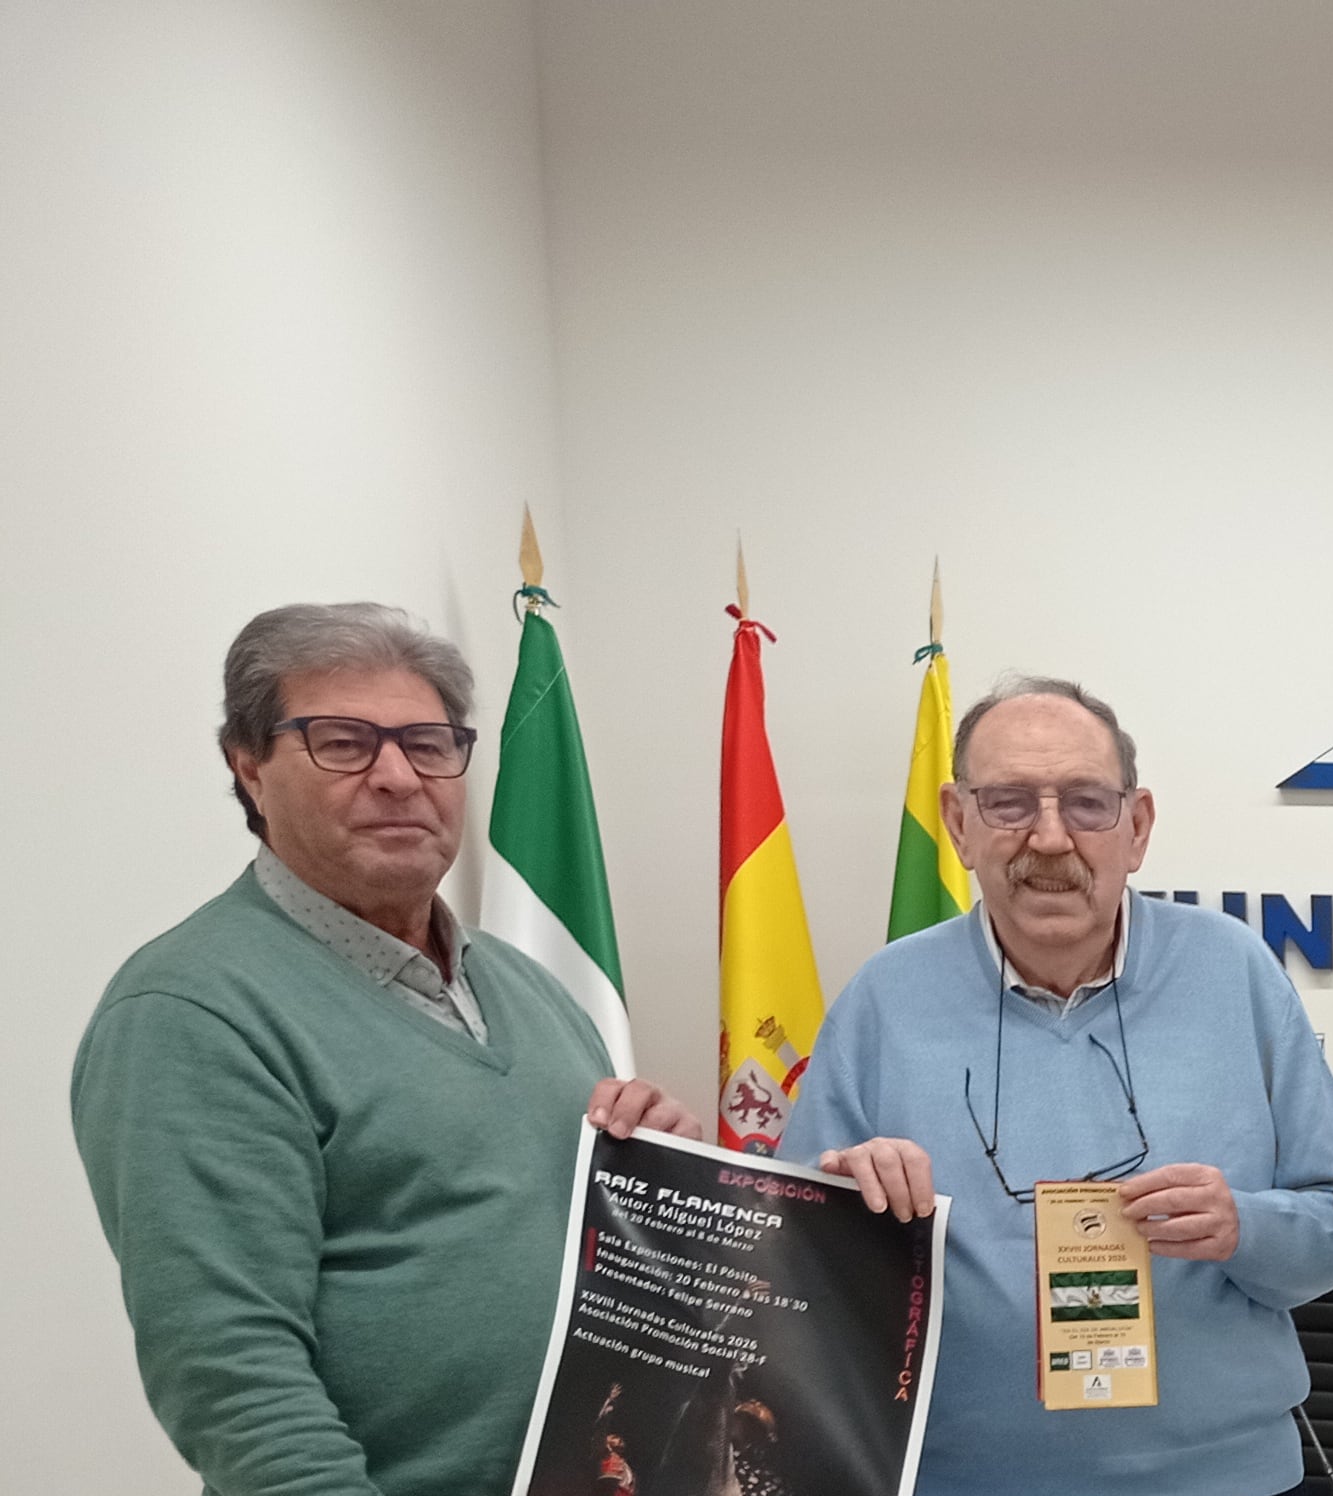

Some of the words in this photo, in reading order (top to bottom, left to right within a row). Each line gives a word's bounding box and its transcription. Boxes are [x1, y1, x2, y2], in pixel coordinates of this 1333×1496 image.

[595, 1170, 649, 1195] RAÍZ
[657, 1187, 783, 1229] FLAMENCA
[717, 1169, 826, 1204] EXPOSICIÓN
[658, 1204, 712, 1228] Miguel
[716, 1219, 762, 1241] López
[722, 1236, 754, 1252] Marzo
[598, 1232, 622, 1248] Sala
[624, 1238, 702, 1272] Exposiciones:
[705, 1262, 718, 1274] El
[719, 1265, 758, 1284] Pósito
[668, 1288, 703, 1308] Felipe
[705, 1298, 753, 1319] Serrano
[675, 1272, 690, 1286] 20
[693, 1277, 739, 1298] Febrero
[753, 1291, 770, 1304] las
[578, 1303, 639, 1331] Asociación
[641, 1324, 699, 1351] Promoción
[701, 1342, 738, 1361] Social
[580, 1289, 615, 1309] XXVIII
[617, 1301, 666, 1327] Jornadas
[668, 1318, 724, 1344] Culturales
[728, 1335, 758, 1351] 2026
[574, 1327, 629, 1353] Actuación
[631, 1347, 663, 1367] grupo
[665, 1358, 711, 1379] musical
